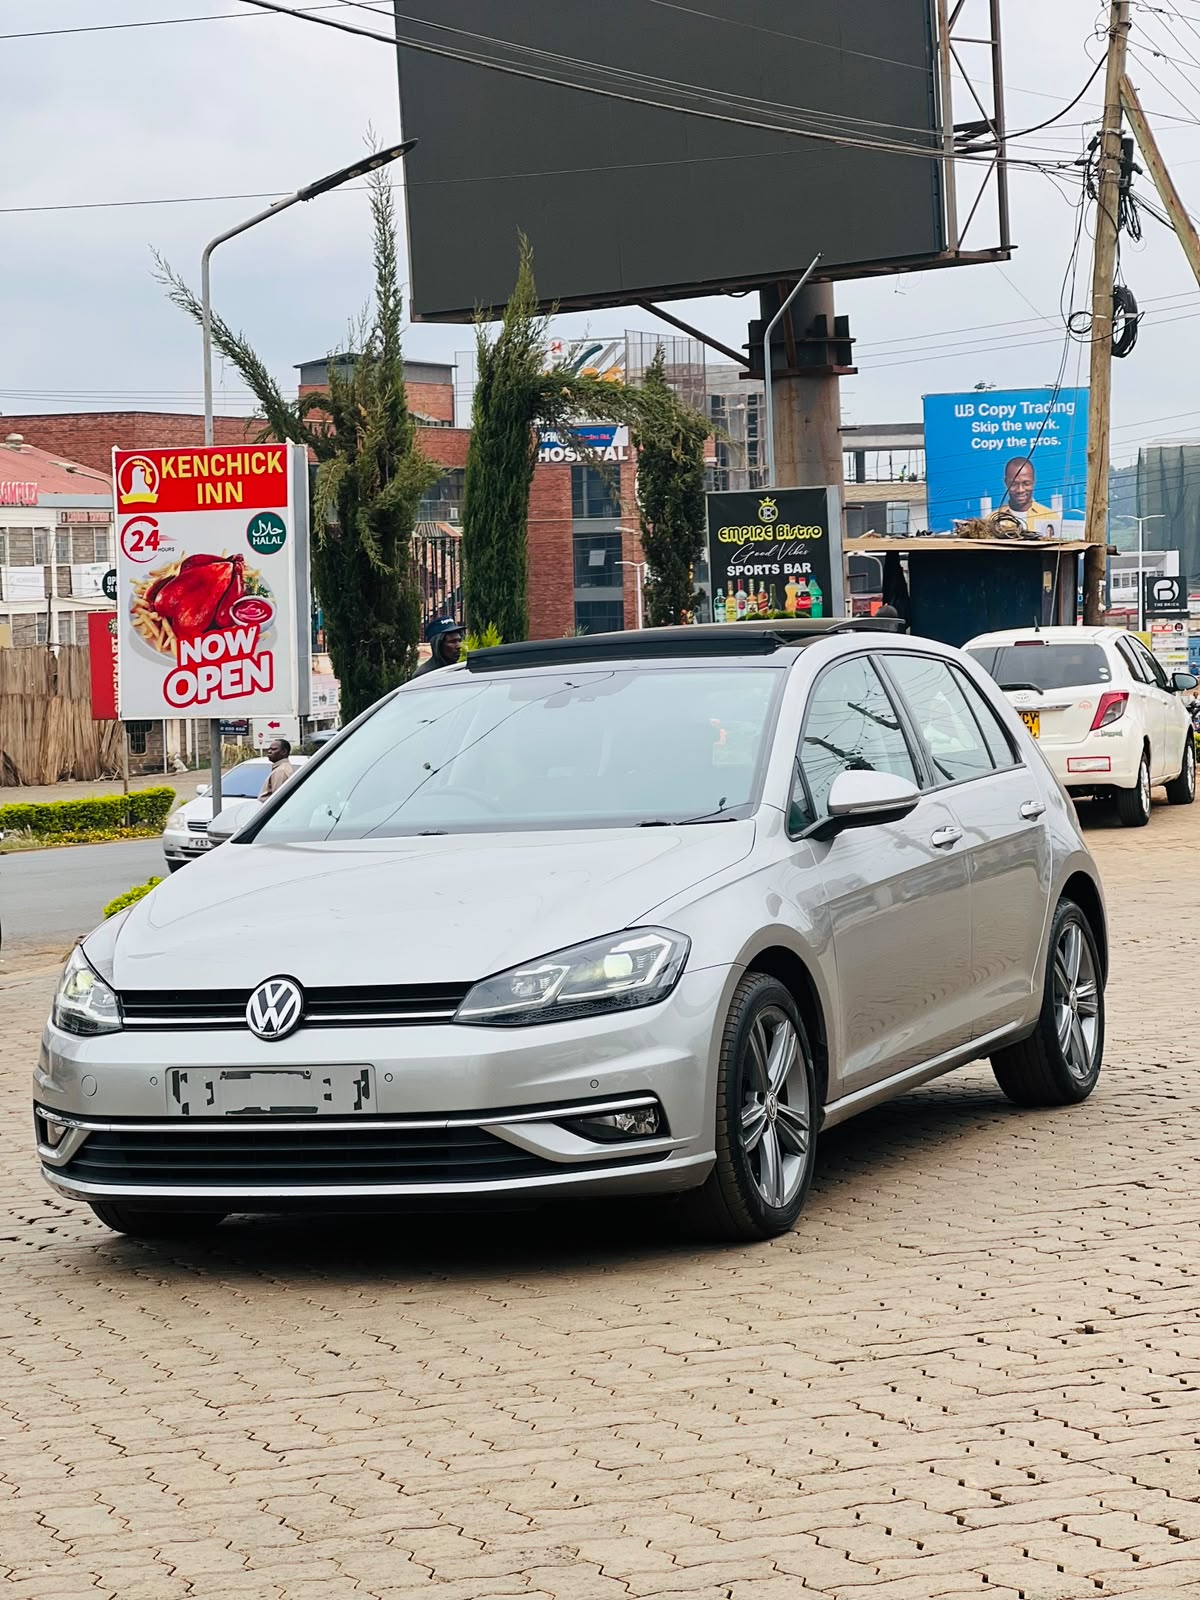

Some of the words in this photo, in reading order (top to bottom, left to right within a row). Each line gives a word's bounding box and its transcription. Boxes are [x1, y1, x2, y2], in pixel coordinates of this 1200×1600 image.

[978, 402, 1016, 418] Copy
[1020, 400, 1076, 415] Trading
[971, 421, 999, 434] Skip
[1001, 420, 1022, 431] the
[1025, 418, 1060, 430] work.
[971, 437, 1004, 450] Copy
[1006, 436, 1027, 447] the
[1030, 436, 1062, 449] pros.
[538, 446, 628, 463] HOSTAL
[161, 451, 283, 479] KENCHICK
[197, 481, 243, 504] INN
[252, 519, 283, 536] حلال
[718, 525, 773, 545] EMPIRE
[776, 524, 822, 540] Bistro
[130, 529, 160, 552] 24
[252, 536, 283, 545] HALAL
[730, 543, 779, 564] Good
[777, 540, 811, 561] Vibes
[727, 564, 780, 576] SPORTS
[783, 562, 812, 574] BAR
[180, 626, 257, 666] NOW
[165, 654, 271, 705] OPEN
